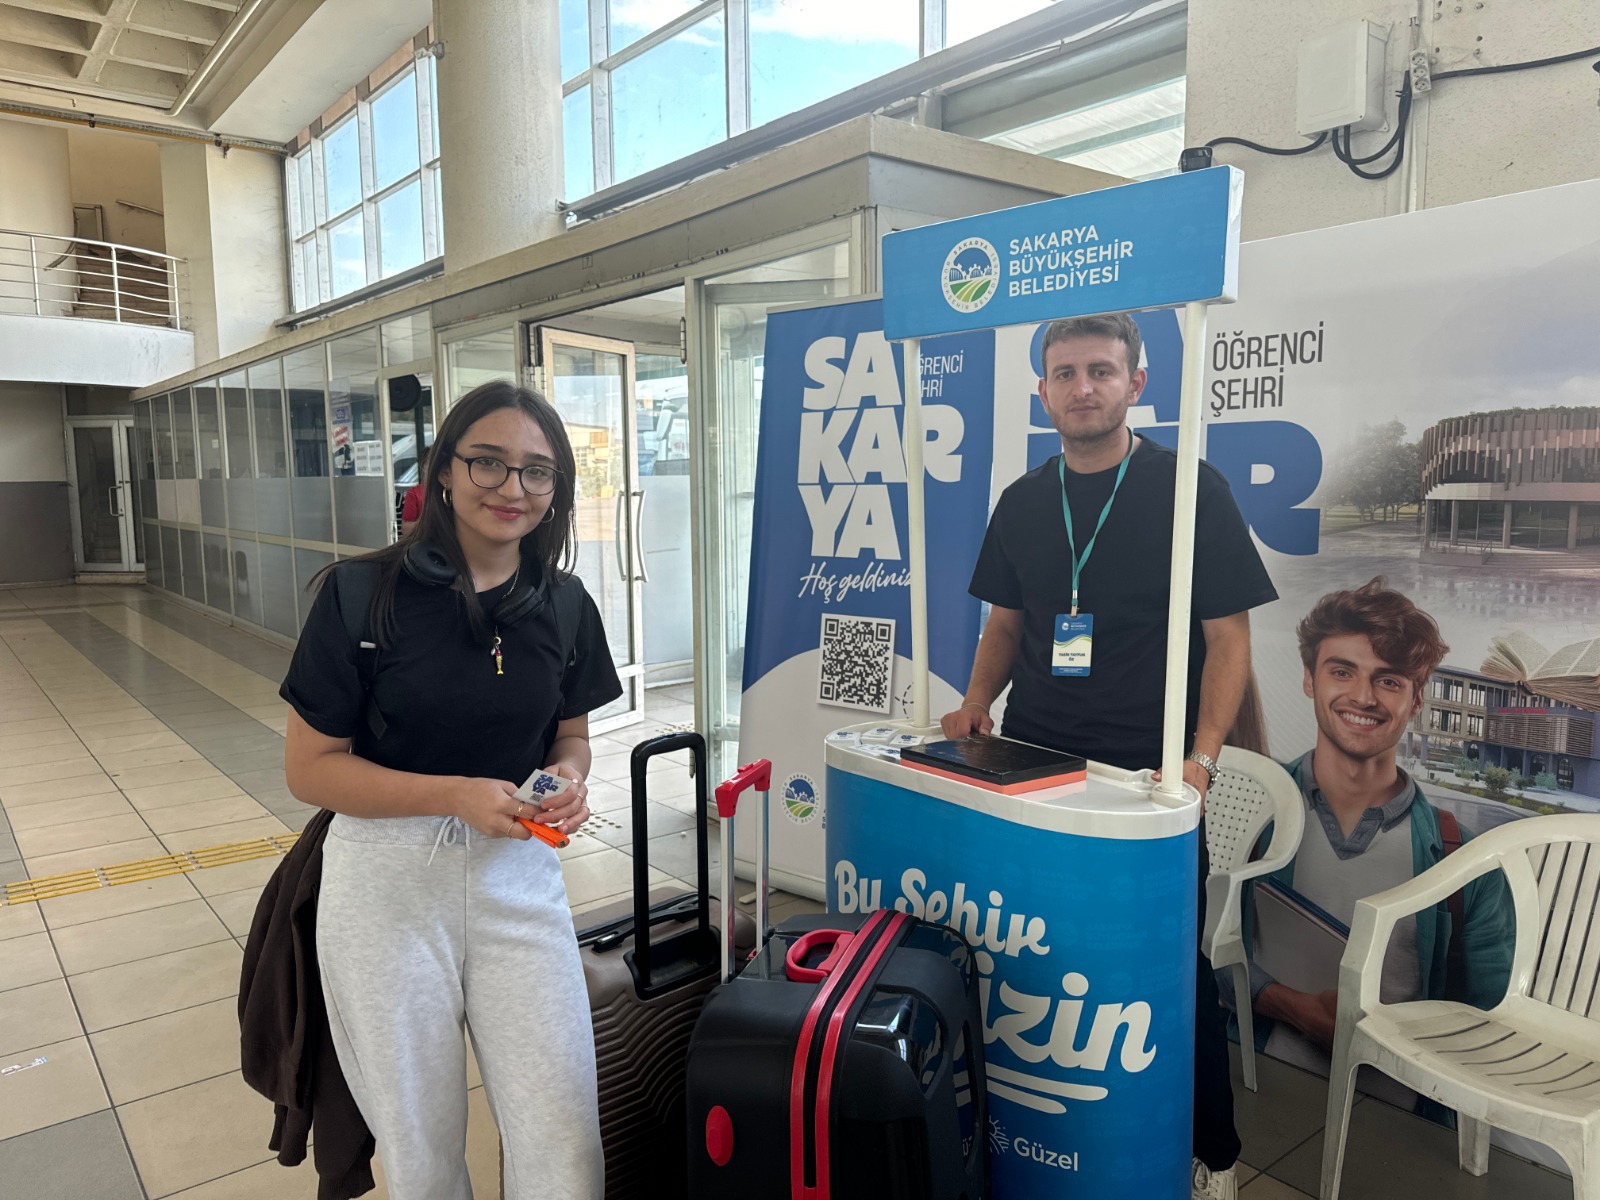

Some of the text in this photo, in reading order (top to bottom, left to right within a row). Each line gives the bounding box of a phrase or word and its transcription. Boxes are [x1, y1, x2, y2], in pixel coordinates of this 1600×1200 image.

[1009, 224, 1099, 256] SAKARYA
[1009, 238, 1134, 276] BÜYÜKŞEHİR
[1009, 260, 1120, 297] BELEDİYESİ
[1212, 320, 1325, 372] ÖĞRENCİ
[802, 330, 903, 410] SA
[920, 374, 944, 398] HRİ
[1210, 366, 1285, 418] ŞEHRİ
[797, 404, 965, 484] KAR
[797, 484, 902, 561] YA
[798, 561, 839, 604] Hoş
[834, 859, 882, 914] Bu
[1013, 1137, 1079, 1171] Güzel
